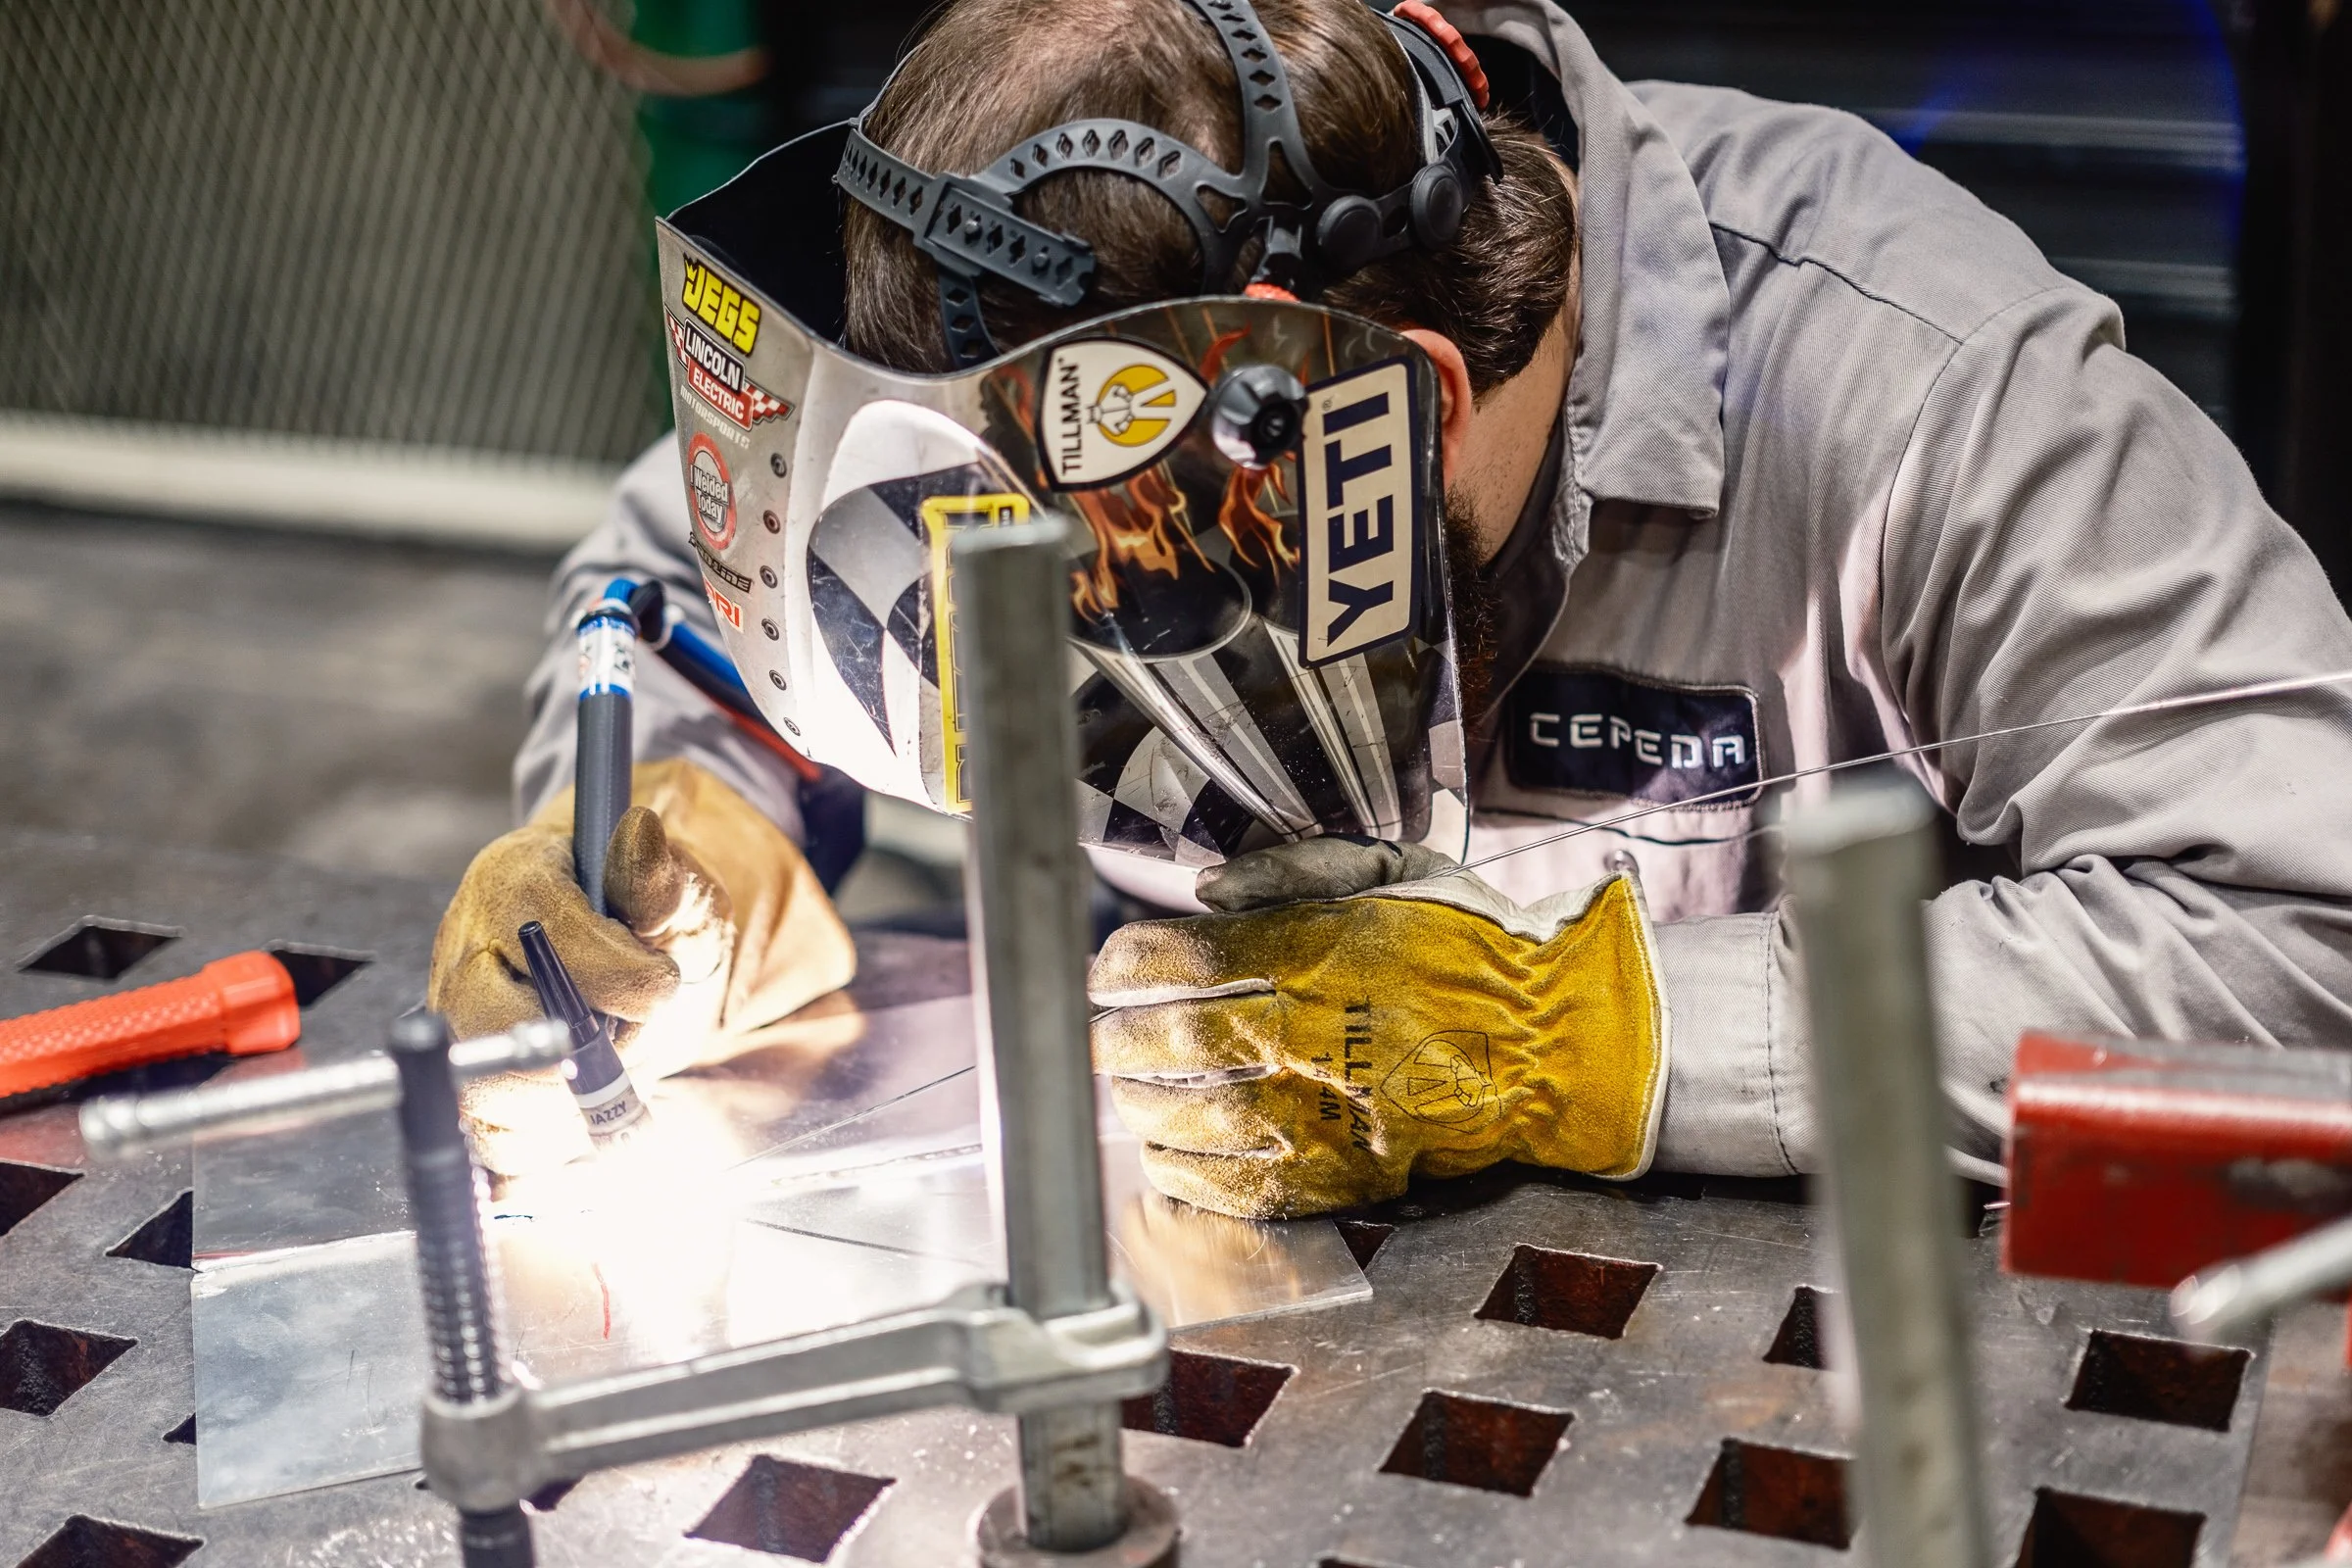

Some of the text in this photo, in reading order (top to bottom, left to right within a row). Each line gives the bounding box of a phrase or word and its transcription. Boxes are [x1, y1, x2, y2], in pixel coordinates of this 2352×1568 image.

[682, 259, 761, 356] JEGS
[685, 326, 741, 391] LINCOLN
[680, 384, 751, 449] MOTORSPORTS
[693, 368, 745, 420] ELECTRIC
[1059, 364, 1083, 476] TILLMAN
[694, 466, 729, 502] Welded
[697, 490, 723, 524] Today
[1322, 391, 1395, 648] YETI
[1530, 712, 1745, 769] CEPEDA
[1310, 1051, 1342, 1121] 144M
[1344, 996, 1374, 1154] TILLMAN
